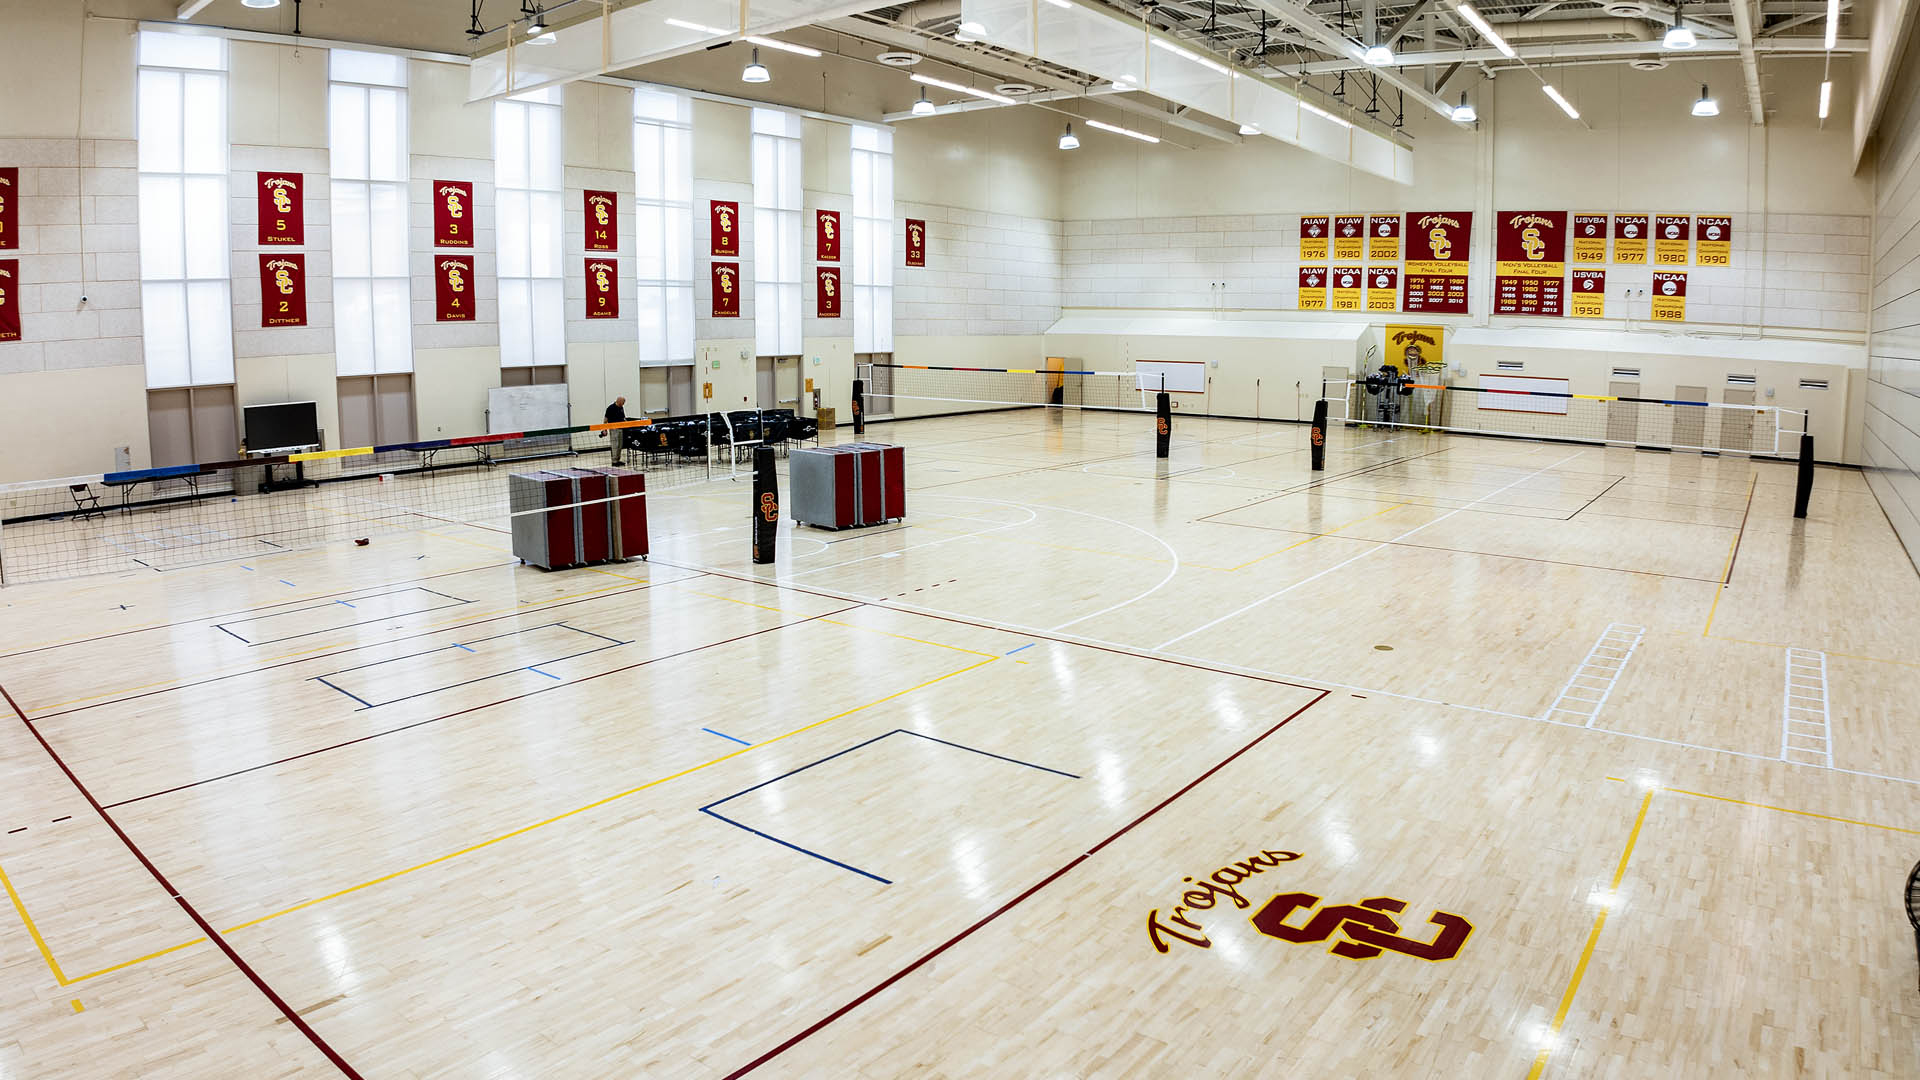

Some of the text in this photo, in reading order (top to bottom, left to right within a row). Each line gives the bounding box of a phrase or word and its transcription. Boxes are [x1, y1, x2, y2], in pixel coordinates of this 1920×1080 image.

[264, 178, 296, 189] Trojans
[440, 186, 467, 196] Trojans
[274, 188, 291, 212] SC
[589, 196, 612, 205] Trojans
[448, 196, 462, 218] SC
[276, 220, 286, 230] 5
[1418, 214, 1460, 229] Trojans
[1510, 214, 1554, 229] Trojans
[450, 224, 458, 234] 3
[595, 230, 607, 239] 14
[722, 237, 728, 245] 8
[1429, 228, 1452, 259] SC
[1522, 228, 1545, 260] SC
[826, 243, 831, 251] 7
[1658, 254, 1685, 262] 1980
[266, 259, 298, 270] Trojans
[440, 260, 468, 270] Trojans
[590, 263, 613, 272] Trojans
[276, 270, 293, 294] SC
[449, 270, 464, 292] SC
[280, 301, 288, 312] 2
[451, 298, 460, 308] 4
[599, 297, 605, 306] 9
[723, 298, 728, 306] 7
[1655, 310, 1682, 318] 1988
[1392, 330, 1436, 346] Trojans
[761, 492, 779, 522] SC
[1147, 850, 1304, 954] Trojans
[1248, 892, 1474, 962] SC
